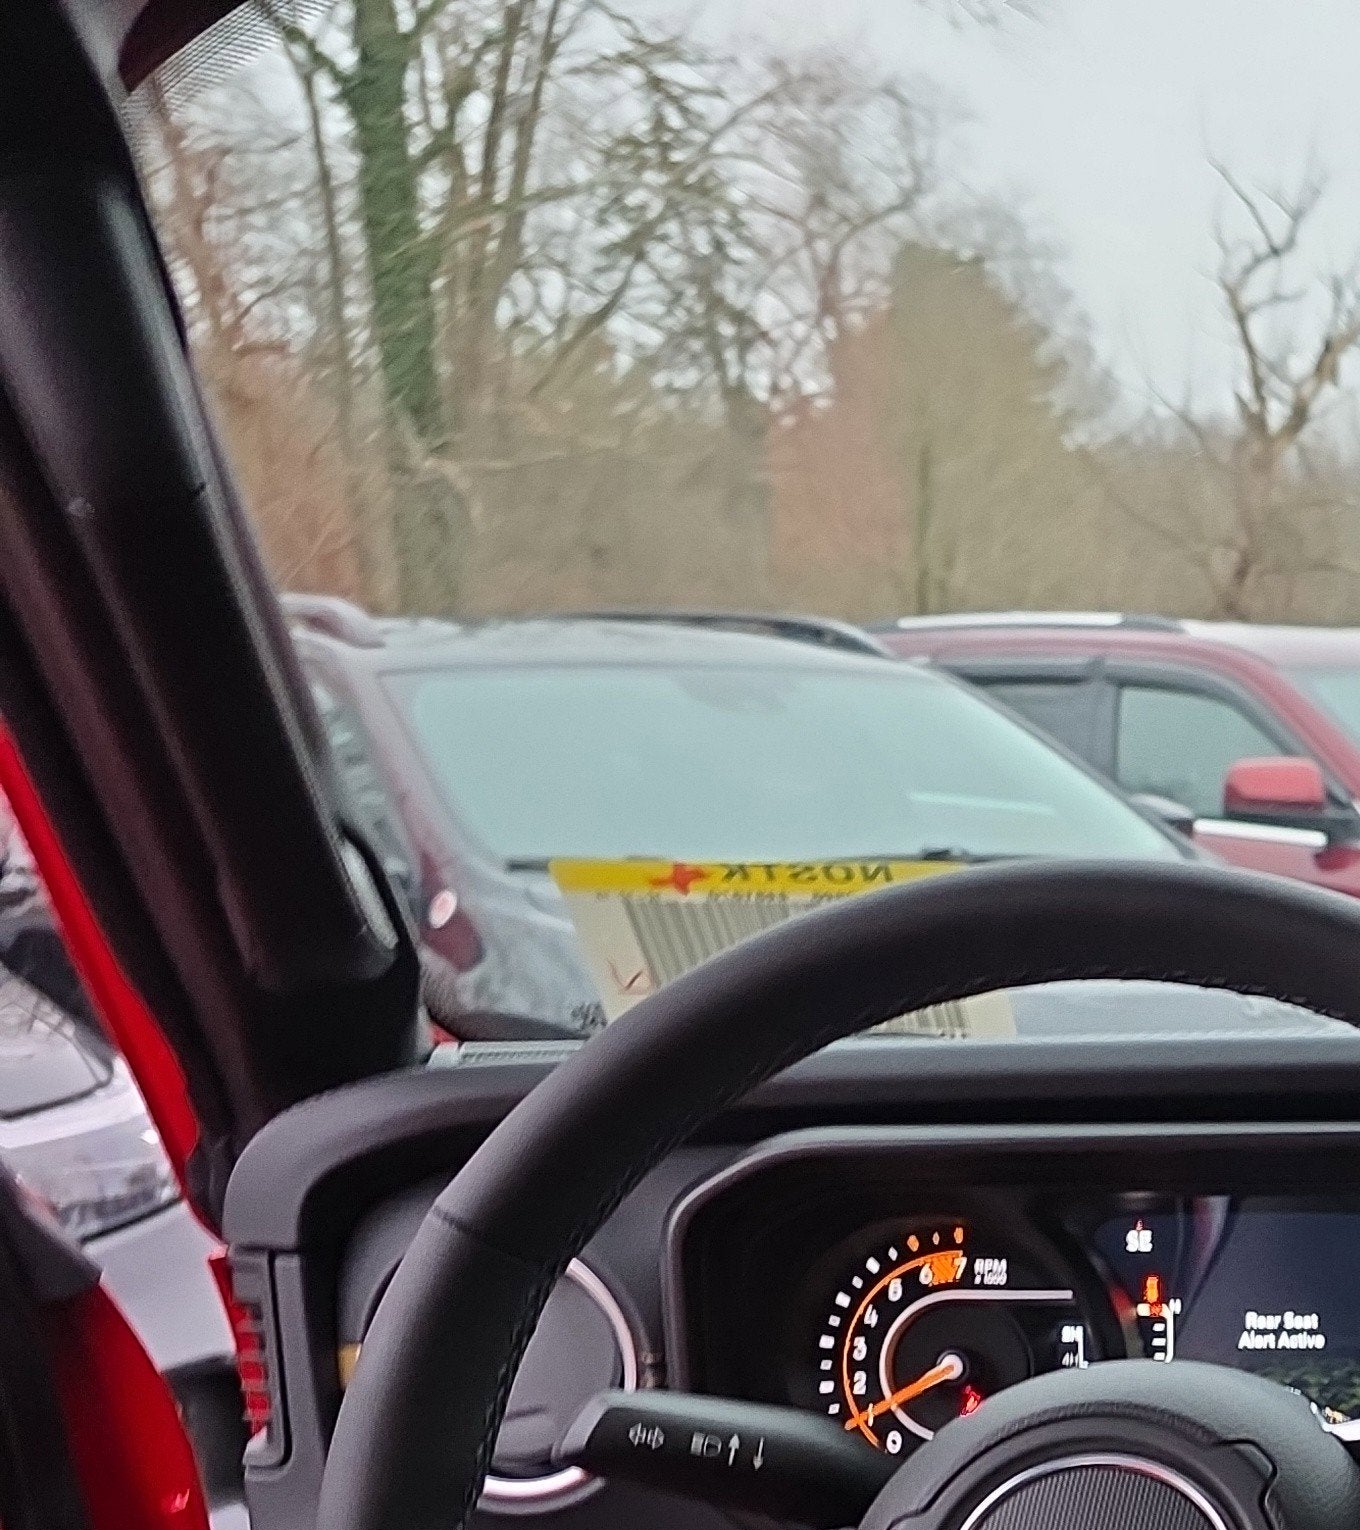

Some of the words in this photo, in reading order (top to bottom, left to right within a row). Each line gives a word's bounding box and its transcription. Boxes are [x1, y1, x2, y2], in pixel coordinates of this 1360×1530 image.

[918, 1263, 933, 1285] 6
[953, 1256, 967, 1281] 7
[863, 1304, 878, 1329] 4
[1244, 1310, 1281, 1330] Rear
[1282, 1310, 1319, 1330] Seat
[852, 1336, 867, 1361] 3
[1237, 1330, 1276, 1350] Alert
[1277, 1330, 1326, 1350] Active
[852, 1370, 867, 1396] 2
[885, 1429, 902, 1454] 0
